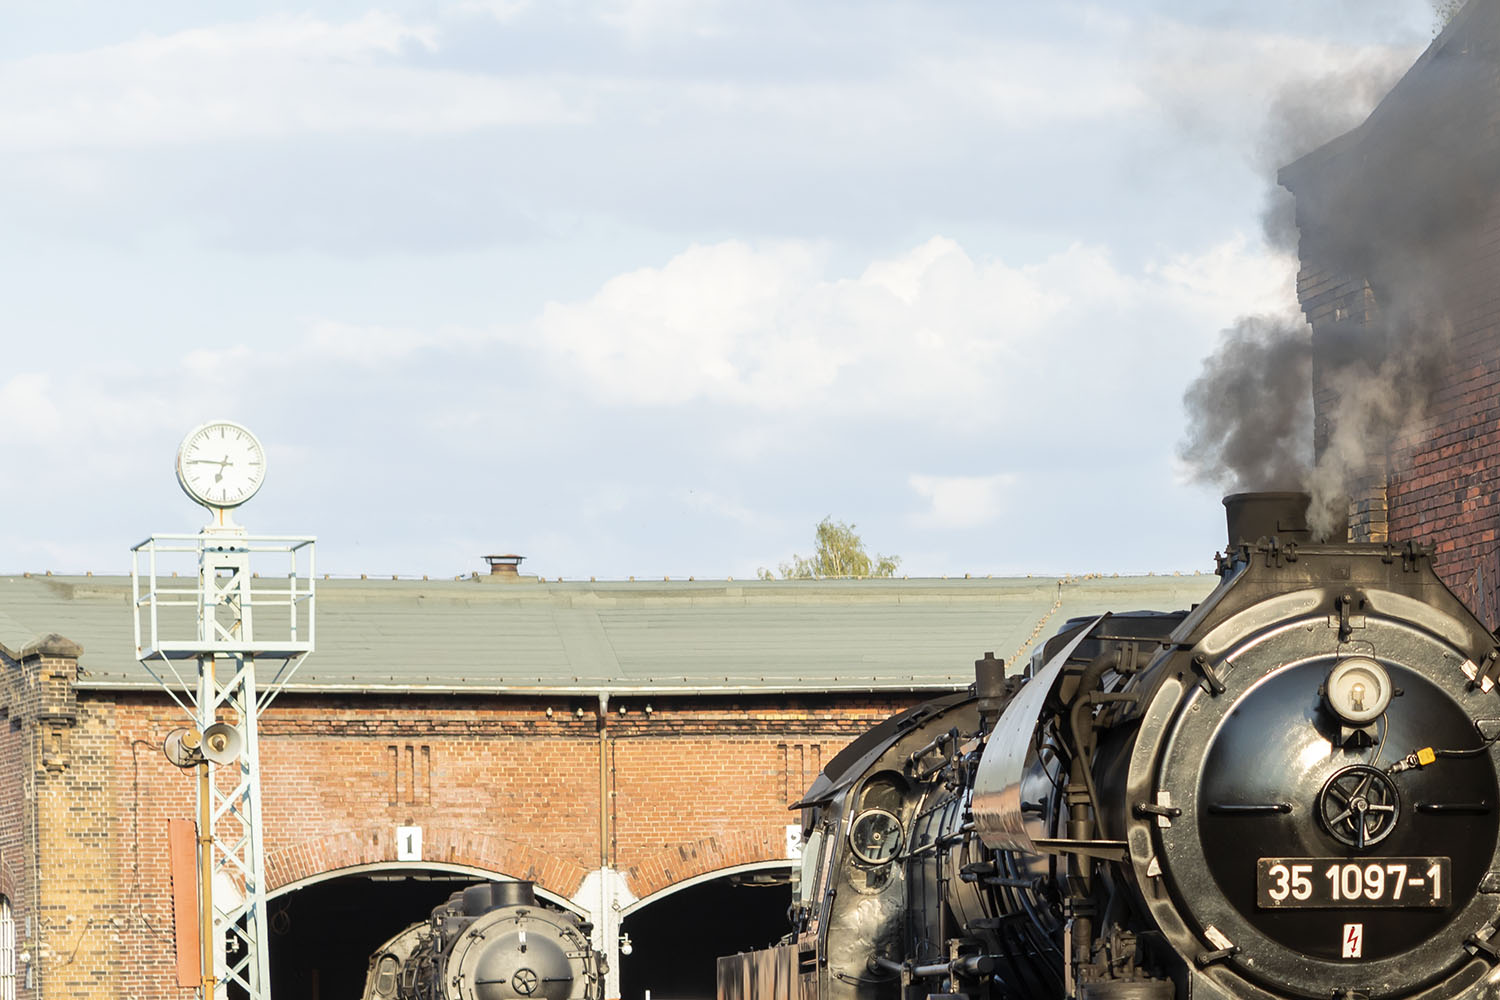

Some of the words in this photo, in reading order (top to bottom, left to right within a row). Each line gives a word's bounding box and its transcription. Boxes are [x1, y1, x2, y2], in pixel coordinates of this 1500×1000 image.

[406, 833, 413, 854] 1
[1268, 864, 1313, 901] 35
[1325, 864, 1441, 901] 1097-1
